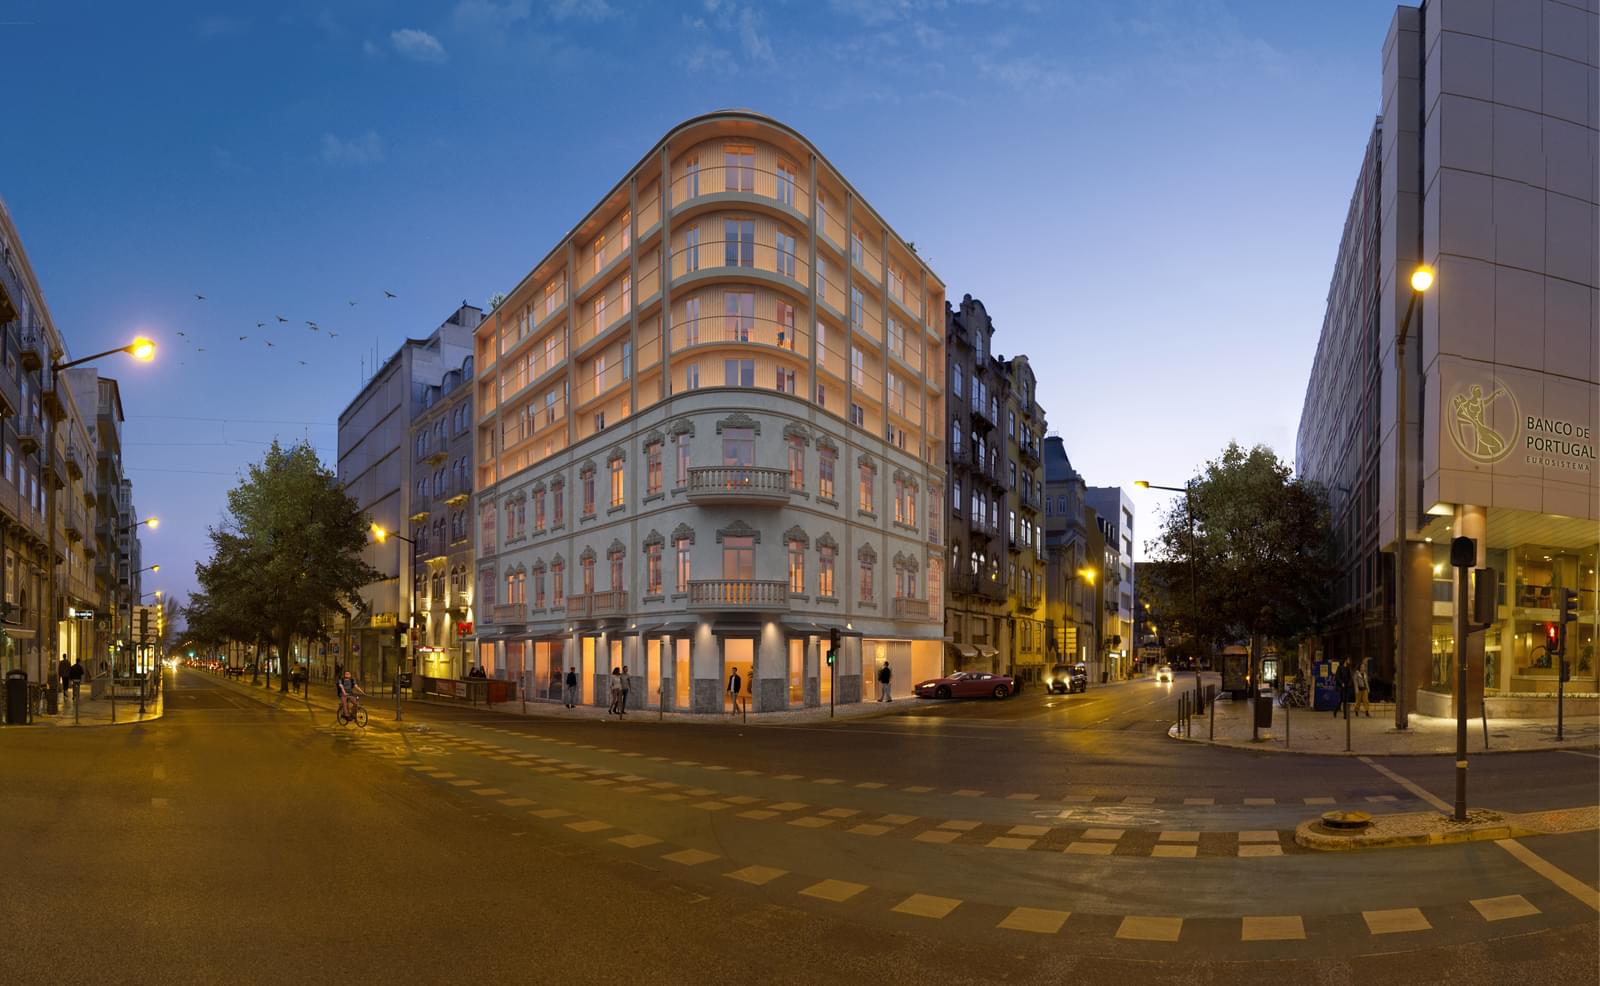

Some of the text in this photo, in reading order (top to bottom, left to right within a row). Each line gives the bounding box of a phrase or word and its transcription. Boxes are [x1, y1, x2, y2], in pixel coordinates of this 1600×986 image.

[1527, 416, 1590, 439] BANCO DE
[1527, 436, 1597, 459] PORTUGAL
[1526, 455, 1590, 471] EUROSISTEMA
